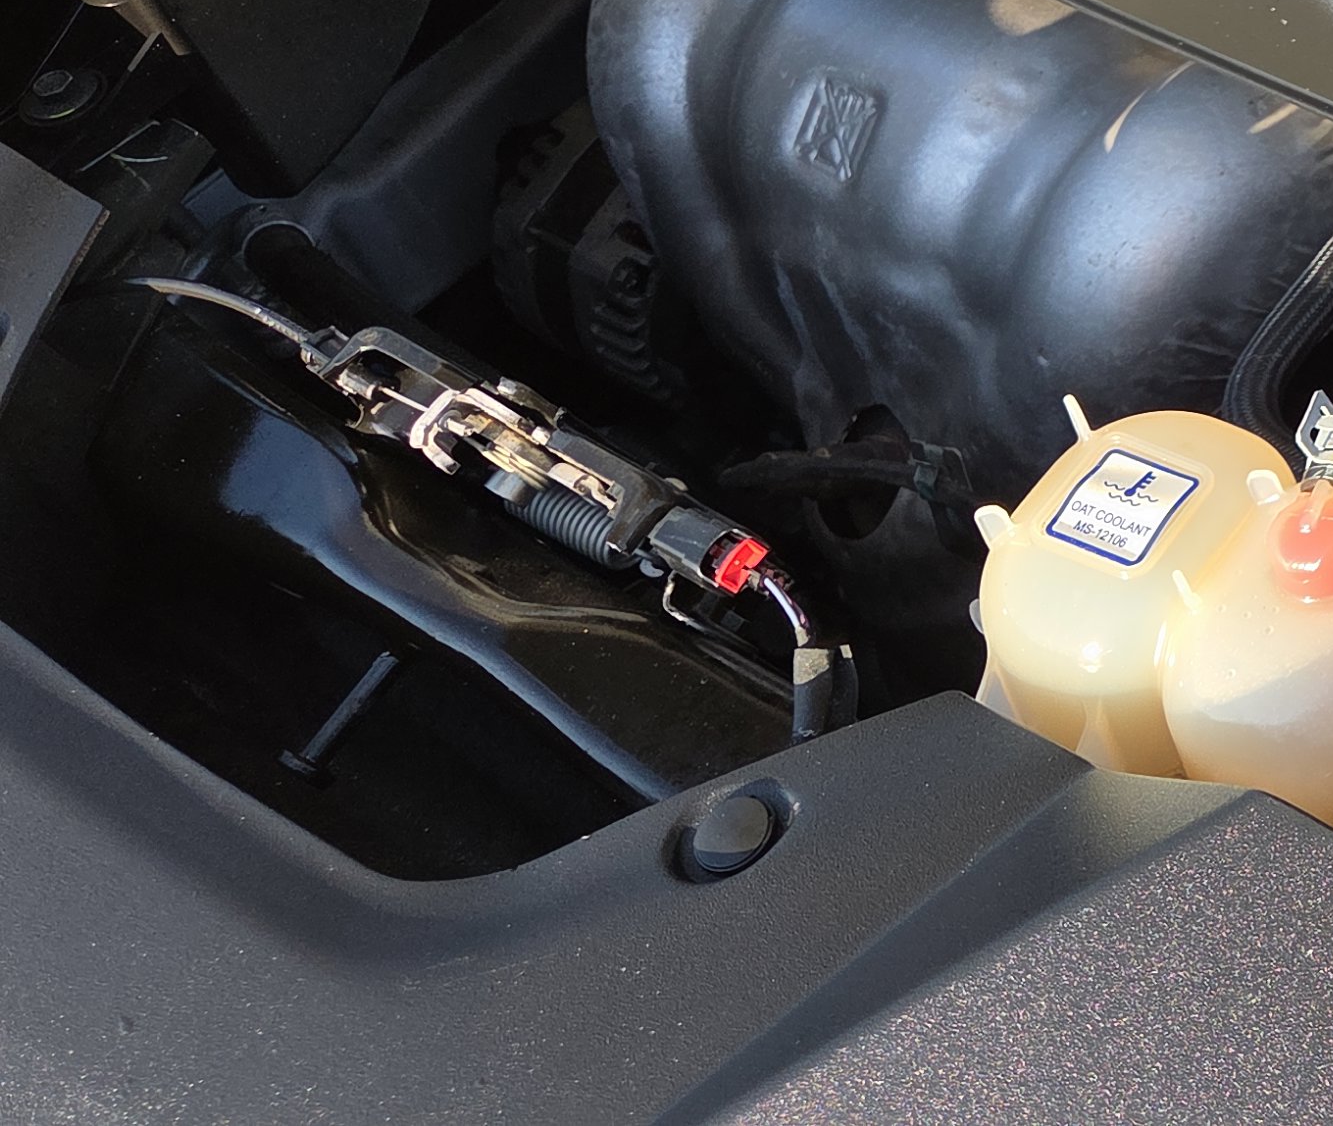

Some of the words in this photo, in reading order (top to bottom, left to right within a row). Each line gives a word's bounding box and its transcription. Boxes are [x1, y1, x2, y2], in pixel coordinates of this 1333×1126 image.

[1071, 500, 1097, 517] OAT
[1095, 509, 1152, 537] COOLANT
[1073, 520, 1129, 548] MS-12106
